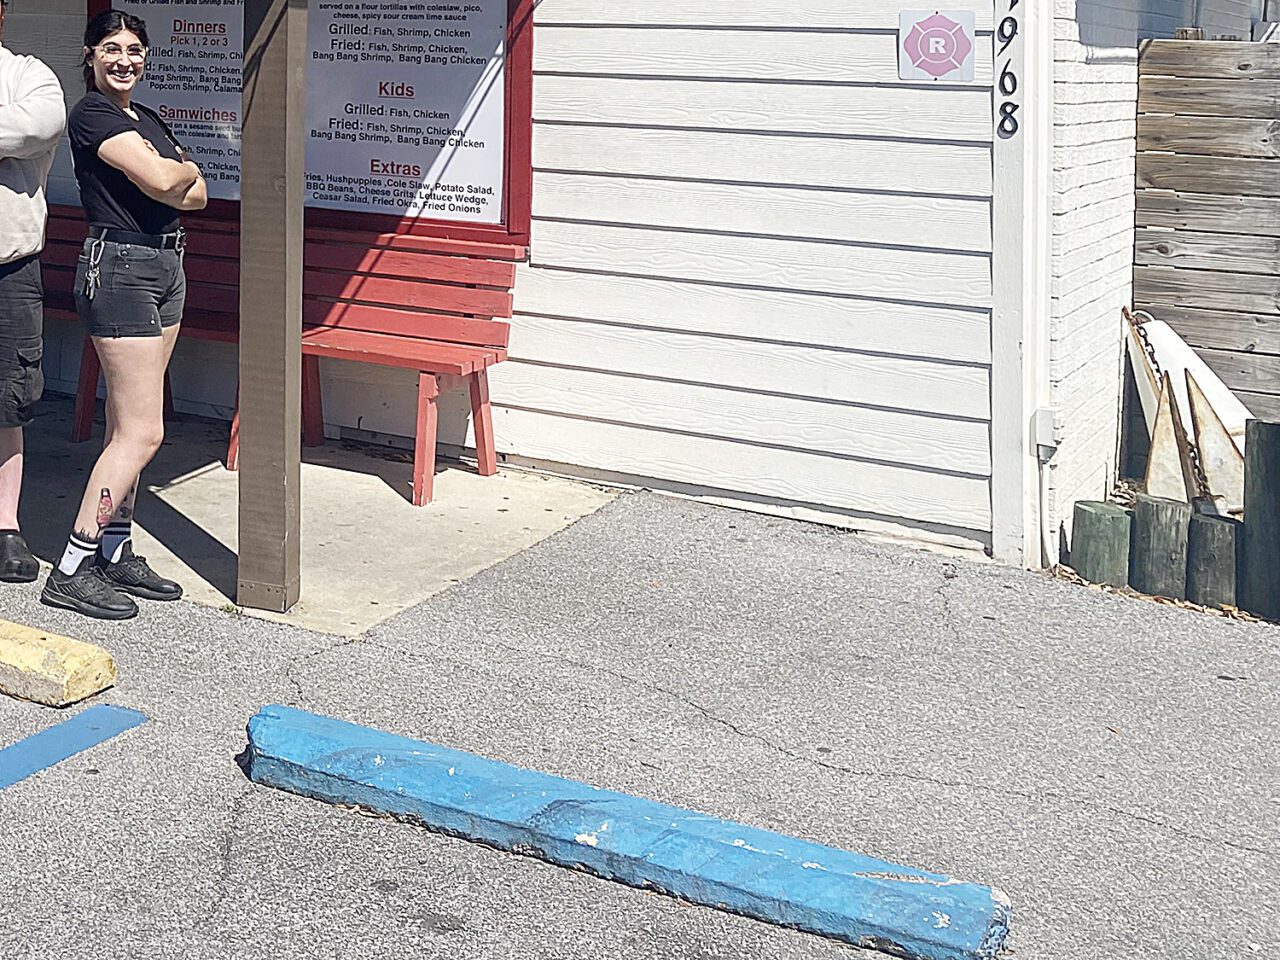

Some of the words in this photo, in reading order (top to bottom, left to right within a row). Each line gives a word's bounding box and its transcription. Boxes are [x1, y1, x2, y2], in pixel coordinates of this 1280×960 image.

[427, 5, 462, 13] coleslaw,
[362, 13, 381, 21] spicy
[426, 13, 442, 21] lime
[173, 20, 226, 33] Dinners
[328, 23, 371, 35] Grilled:
[373, 28, 395, 36] Fish,
[397, 28, 432, 38] Shrimp,
[434, 28, 470, 38] Chicken
[170, 36, 189, 45] Pick
[193, 37, 199, 46] 1,
[203, 37, 208, 45] 2
[222, 38, 228, 46] 3
[330, 39, 365, 50] Fried:
[369, 43, 390, 52] Fish,
[391, 43, 426, 54] Shrimp,
[428, 44, 468, 55] Chicken,
[929, 37, 946, 54] R
[178, 51, 196, 59] Fish,
[198, 51, 227, 60] Shrimp,
[313, 51, 335, 62] Bang
[336, 52, 358, 62] Bang
[360, 53, 394, 63] Shrimp,
[399, 55, 423, 65] Bang
[424, 55, 448, 65] Bang
[450, 55, 486, 65] Chicken
[158, 64, 176, 72] Fish,
[178, 65, 207, 74] Shrimp,
[145, 73, 164, 82] Bang
[166, 74, 195, 84] Shrimp,
[200, 75, 219, 86] Bang
[221, 76, 241, 86] Bang
[149, 82, 180, 90] Popcorn
[182, 82, 211, 93] Shrimp,
[379, 82, 414, 96] Kids
[159, 105, 237, 121] Samwiches
[344, 103, 387, 116] Grilled:
[389, 109, 411, 118] Fish,
[413, 110, 450, 120] Chicken
[329, 118, 363, 130] Fried:
[367, 123, 388, 132] Fish,
[390, 124, 424, 135] Shrimp,
[426, 126, 466, 137] Chicken,
[311, 130, 332, 140] Bang
[335, 131, 357, 141] Bang
[359, 132, 392, 144] Shrimp,
[397, 135, 420, 146] Bang
[423, 136, 446, 148] Bang
[448, 139, 485, 148] Chicken
[196, 146, 226, 157] Shrimp,
[207, 162, 240, 172] Chicken,
[370, 159, 421, 176] Extras
[220, 173, 239, 183] Bang
[326, 174, 382, 186] Hushpuppies
[409, 180, 433, 191] Slaw,
[435, 183, 464, 193] Potato
[466, 185, 495, 196] Salad,
[306, 182, 325, 191] BBQ
[327, 184, 356, 193] Beans,
[358, 186, 391, 196] Cheese
[393, 188, 416, 199] Grits,
[419, 191, 453, 202] Lettuce
[455, 194, 488, 206] Wedge,
[313, 192, 341, 202] Ceasar
[344, 194, 370, 204] Salad,
[372, 196, 394, 206] Fried
[397, 199, 420, 209] Okra,
[422, 202, 446, 211] Fried
[448, 204, 481, 214] Onions
